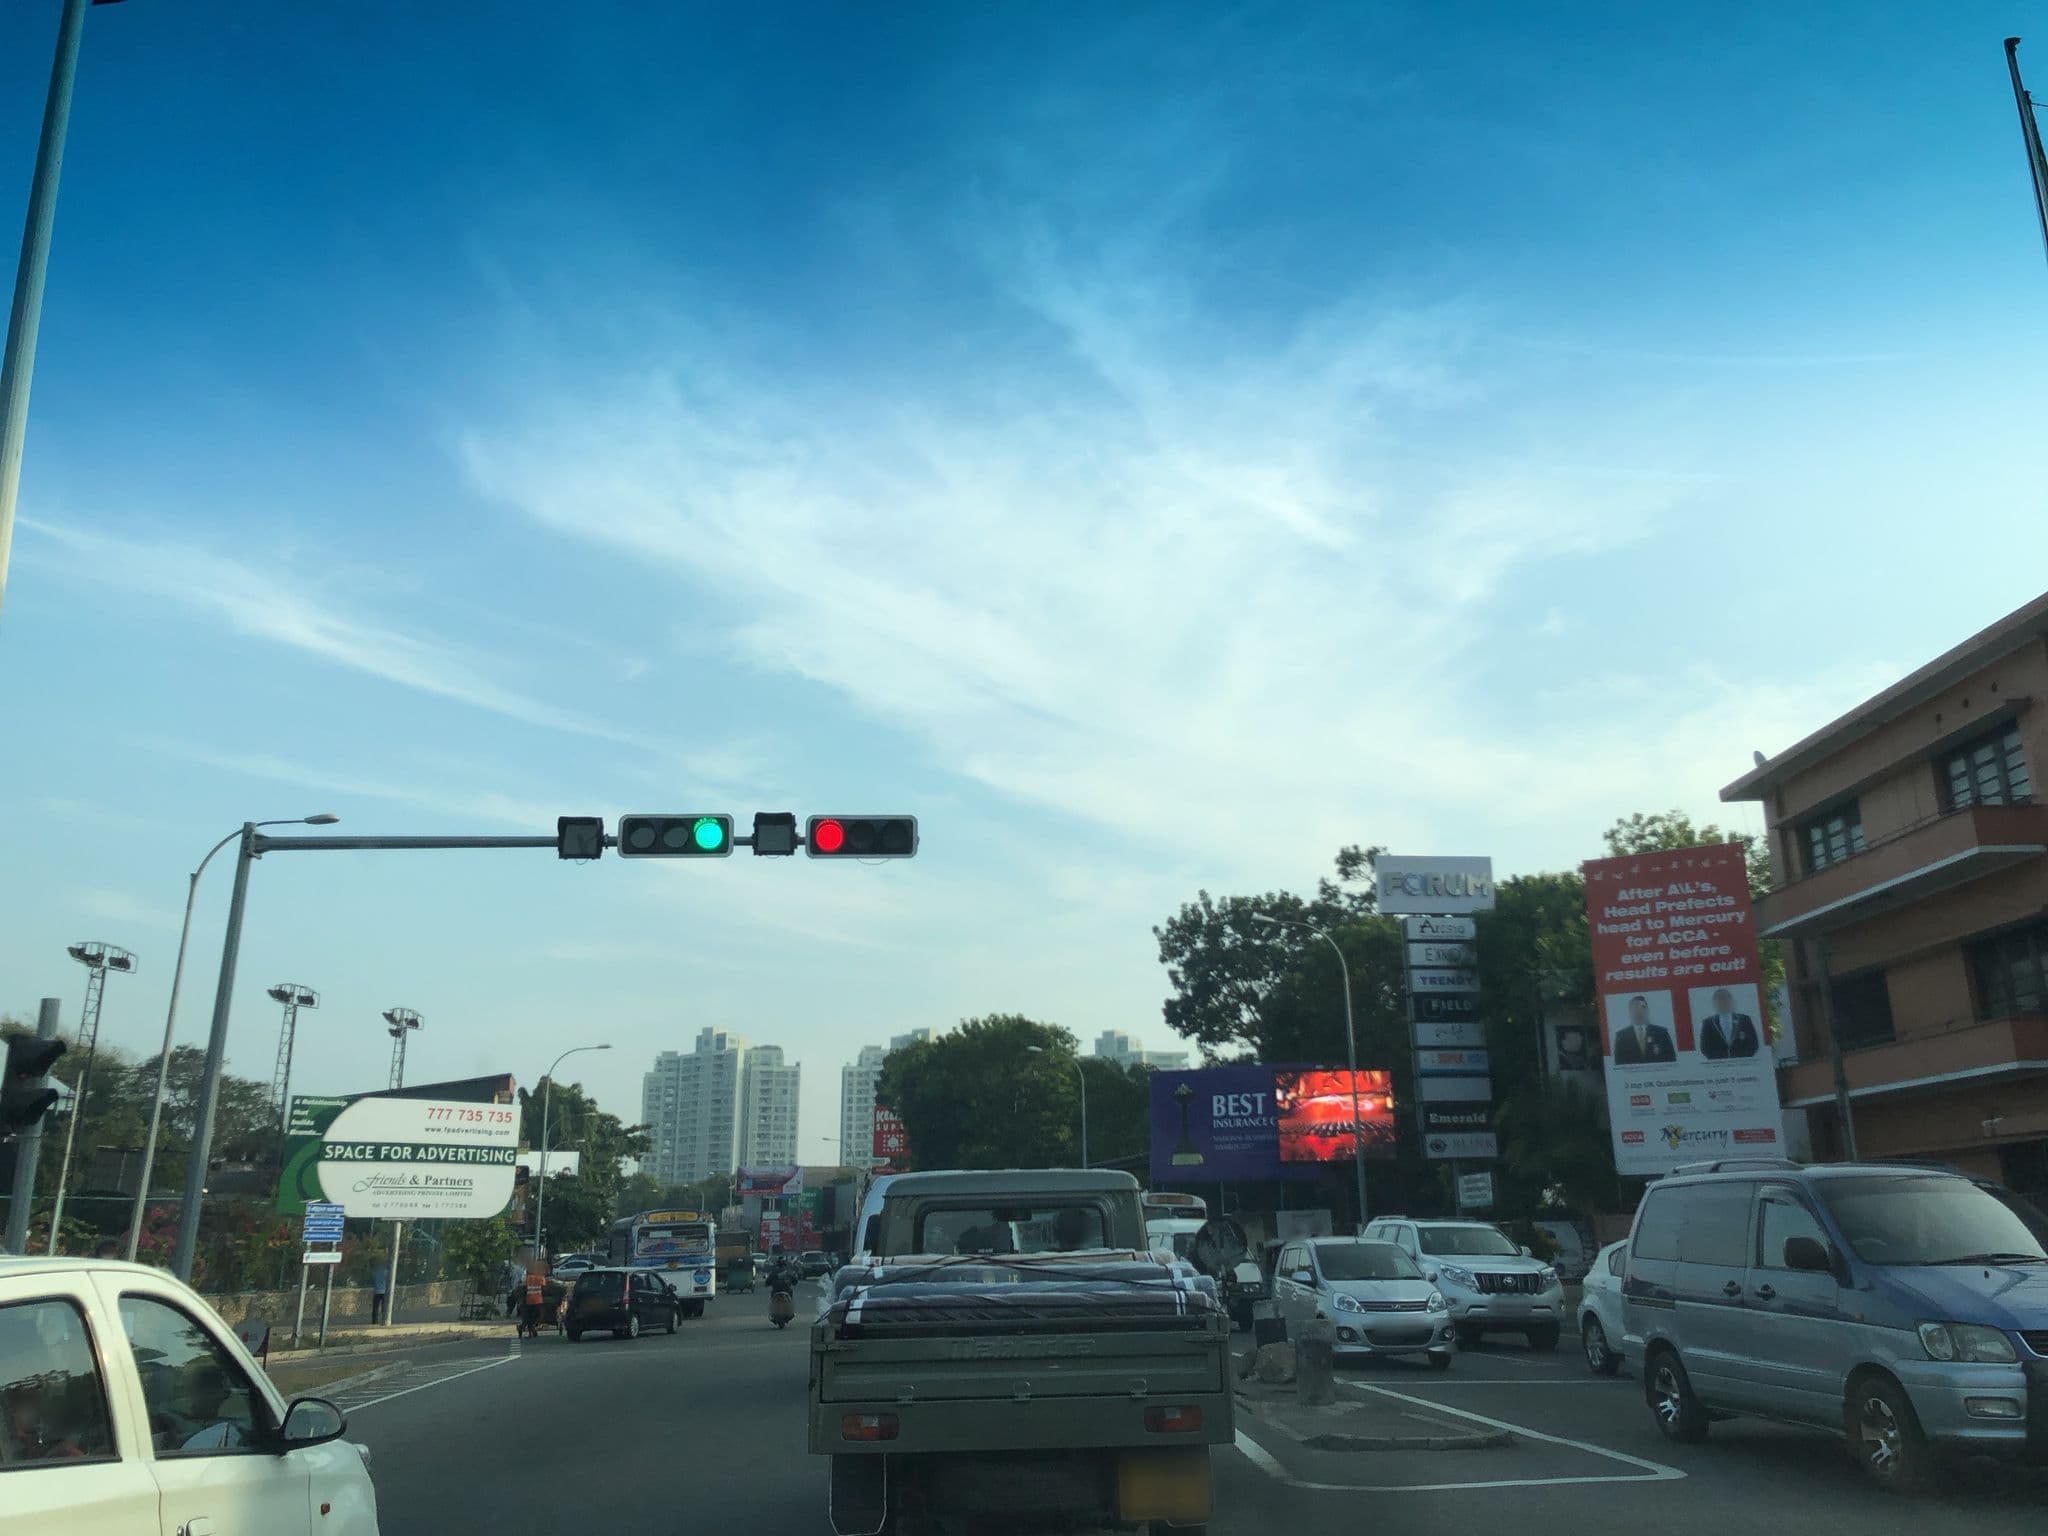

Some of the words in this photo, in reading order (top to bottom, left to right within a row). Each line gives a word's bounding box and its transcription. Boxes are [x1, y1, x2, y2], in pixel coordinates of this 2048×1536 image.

[1383, 871, 1489, 896] FORUM
[1617, 887, 1663, 901] After
[1604, 903, 1650, 918] Head
[1655, 895, 1736, 913] Prefects
[1597, 920, 1641, 934] head
[1646, 917, 1664, 930] to
[1670, 911, 1745, 927] Mercury
[1625, 935, 1652, 948] for
[1657, 929, 1708, 944] ACCA
[1621, 951, 1664, 964] even
[1669, 944, 1731, 959] before
[1605, 966, 1668, 981] results
[1673, 963, 1705, 975] are
[1710, 957, 1746, 972] out!
[1213, 1093, 1266, 1117] BEST
[428, 1107, 453, 1120] 777
[458, 1109, 483, 1122] 735
[488, 1111, 513, 1124] 735
[1213, 1118, 1269, 1128] INSURANCE
[1429, 1111, 1488, 1123] Emerald
[325, 1144, 374, 1159] SPACE
[381, 1146, 412, 1160] FOR
[416, 1147, 516, 1163] ADVERTISING
[409, 1175, 420, 1185] &
[425, 1175, 473, 1187] Partners
